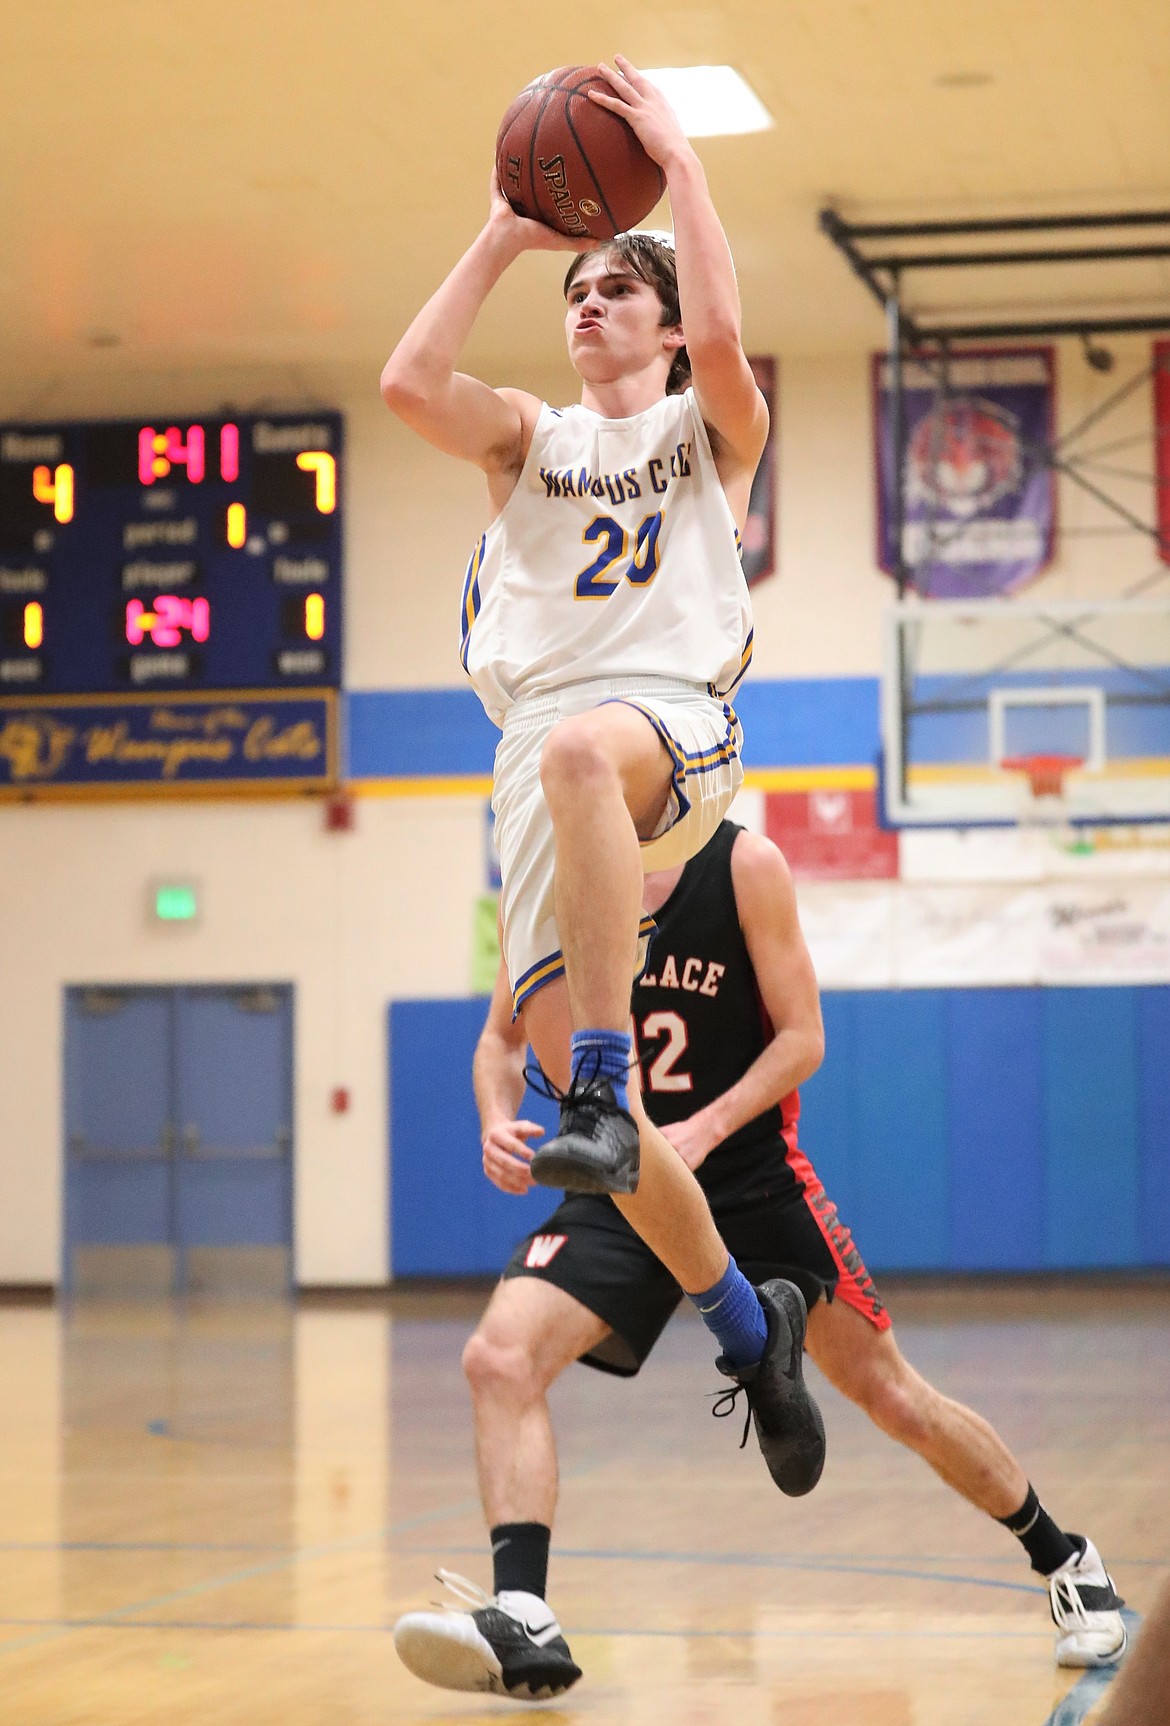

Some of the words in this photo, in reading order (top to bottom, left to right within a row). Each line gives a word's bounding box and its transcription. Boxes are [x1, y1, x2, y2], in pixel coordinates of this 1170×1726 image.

[33, 463, 74, 523] 4
[296, 451, 336, 514] 7
[227, 502, 246, 549] 1
[573, 508, 666, 601] 20
[24, 601, 43, 649] 1
[305, 593, 324, 640] 1
[523, 1232, 569, 1269] W
